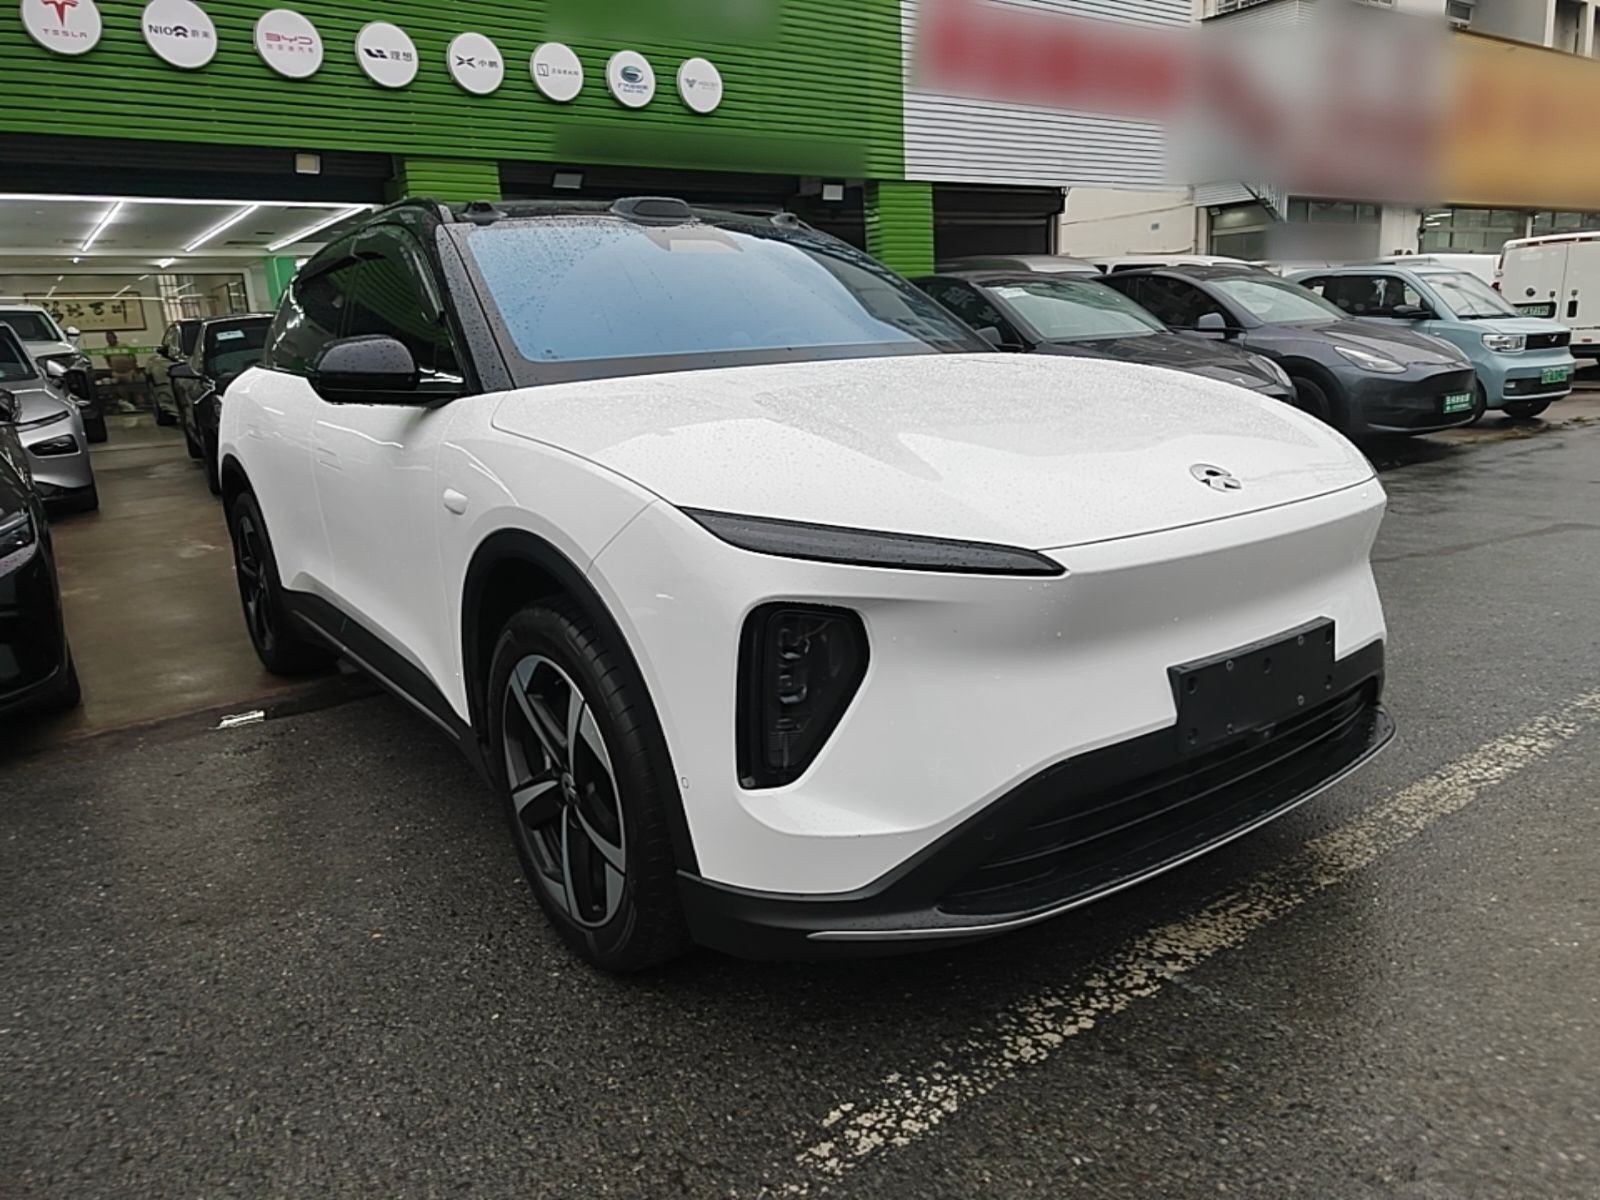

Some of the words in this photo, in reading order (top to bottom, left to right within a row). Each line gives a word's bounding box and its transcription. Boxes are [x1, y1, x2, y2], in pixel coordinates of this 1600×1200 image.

[42, 28, 87, 38] TESLA
[148, 24, 173, 36] NIO
[265, 32, 313, 45] BYD
